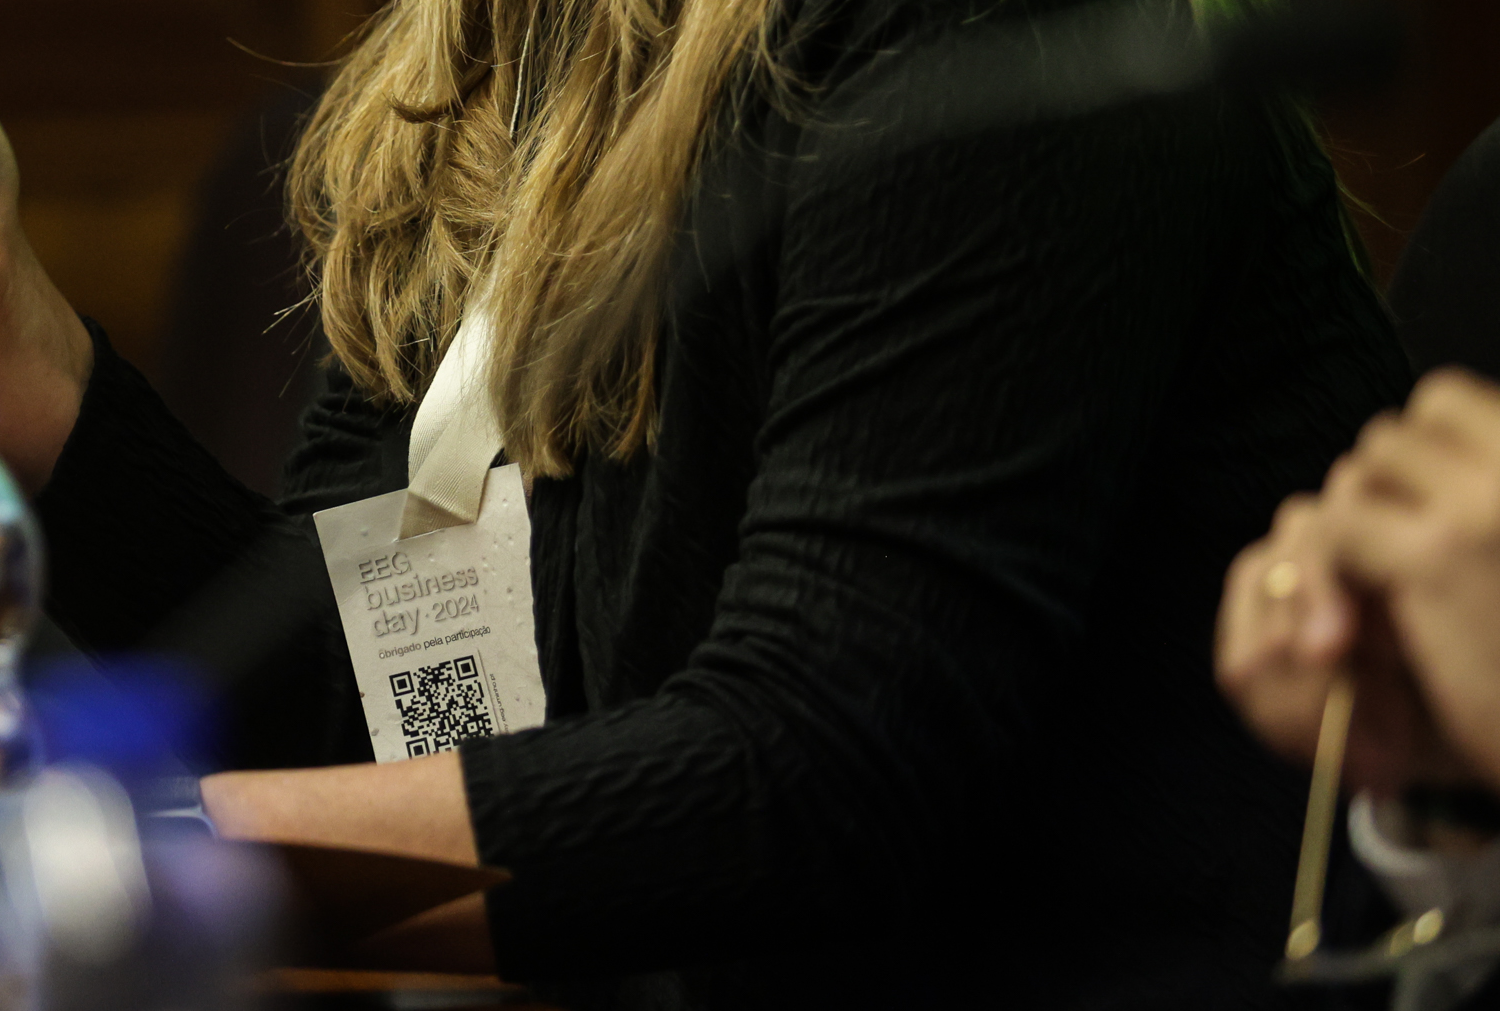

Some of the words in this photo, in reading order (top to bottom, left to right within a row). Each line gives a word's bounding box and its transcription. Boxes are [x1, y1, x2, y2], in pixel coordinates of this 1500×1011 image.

[358, 551, 412, 584] EEG
[364, 566, 479, 610] business
[373, 607, 420, 637] day
[431, 594, 480, 622] 2024
[423, 637, 444, 649] pela
[445, 626, 491, 645] participação
